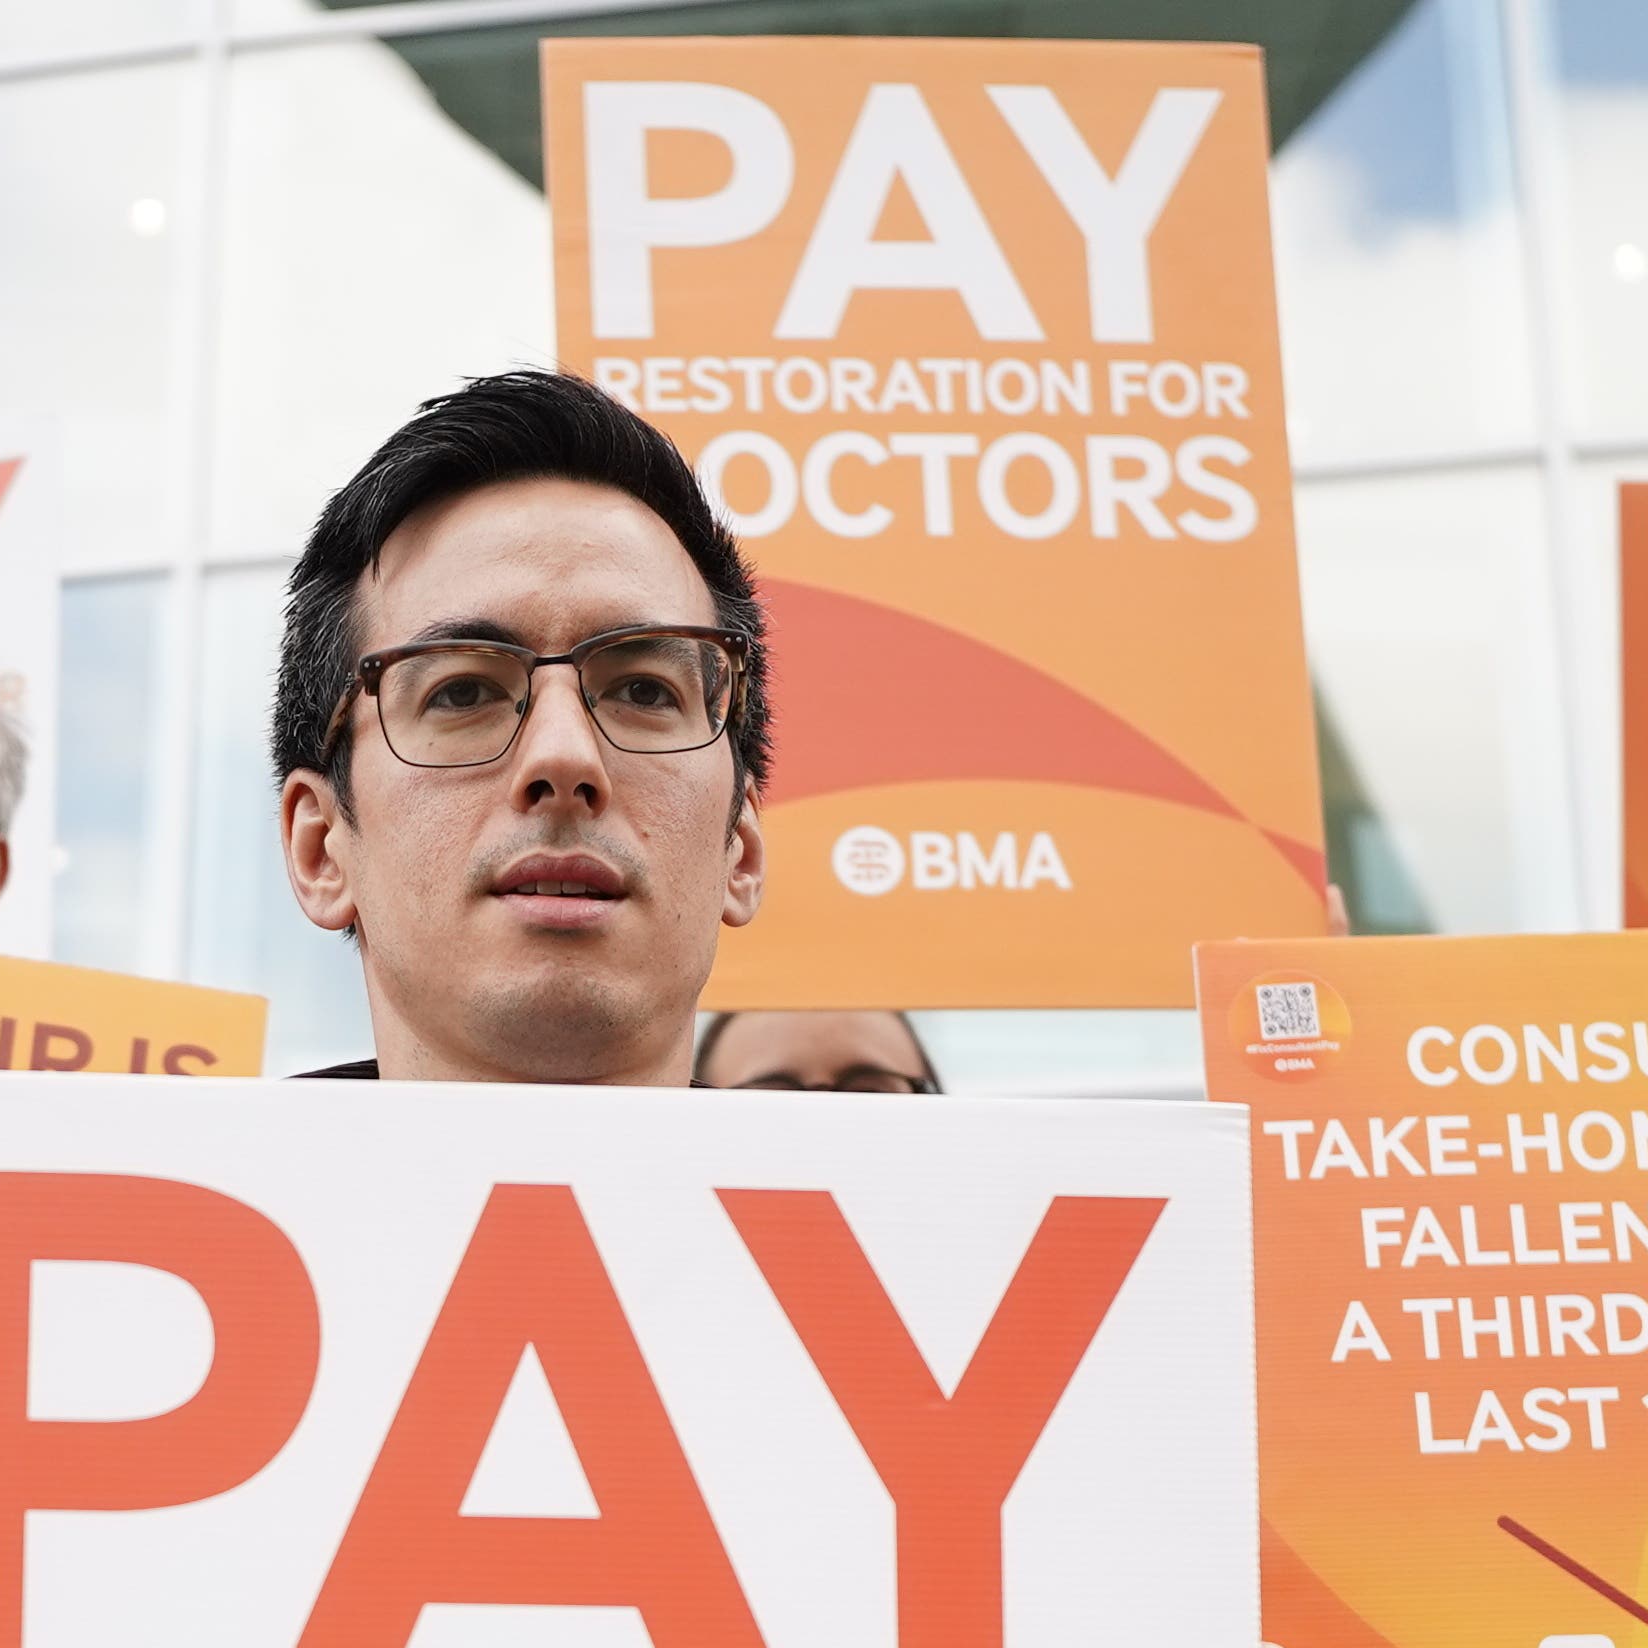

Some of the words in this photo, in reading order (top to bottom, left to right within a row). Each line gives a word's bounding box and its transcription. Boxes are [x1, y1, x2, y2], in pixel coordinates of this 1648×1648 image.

[581, 79, 1225, 343] PAY
[593, 356, 1091, 416] RESTORATION
[1110, 360, 1251, 419] FOR
[697, 430, 1259, 541] OCTORS
[910, 831, 1073, 891] BMA
[1331, 1300, 1390, 1364] A
[1414, 1386, 1620, 1454] LAST
